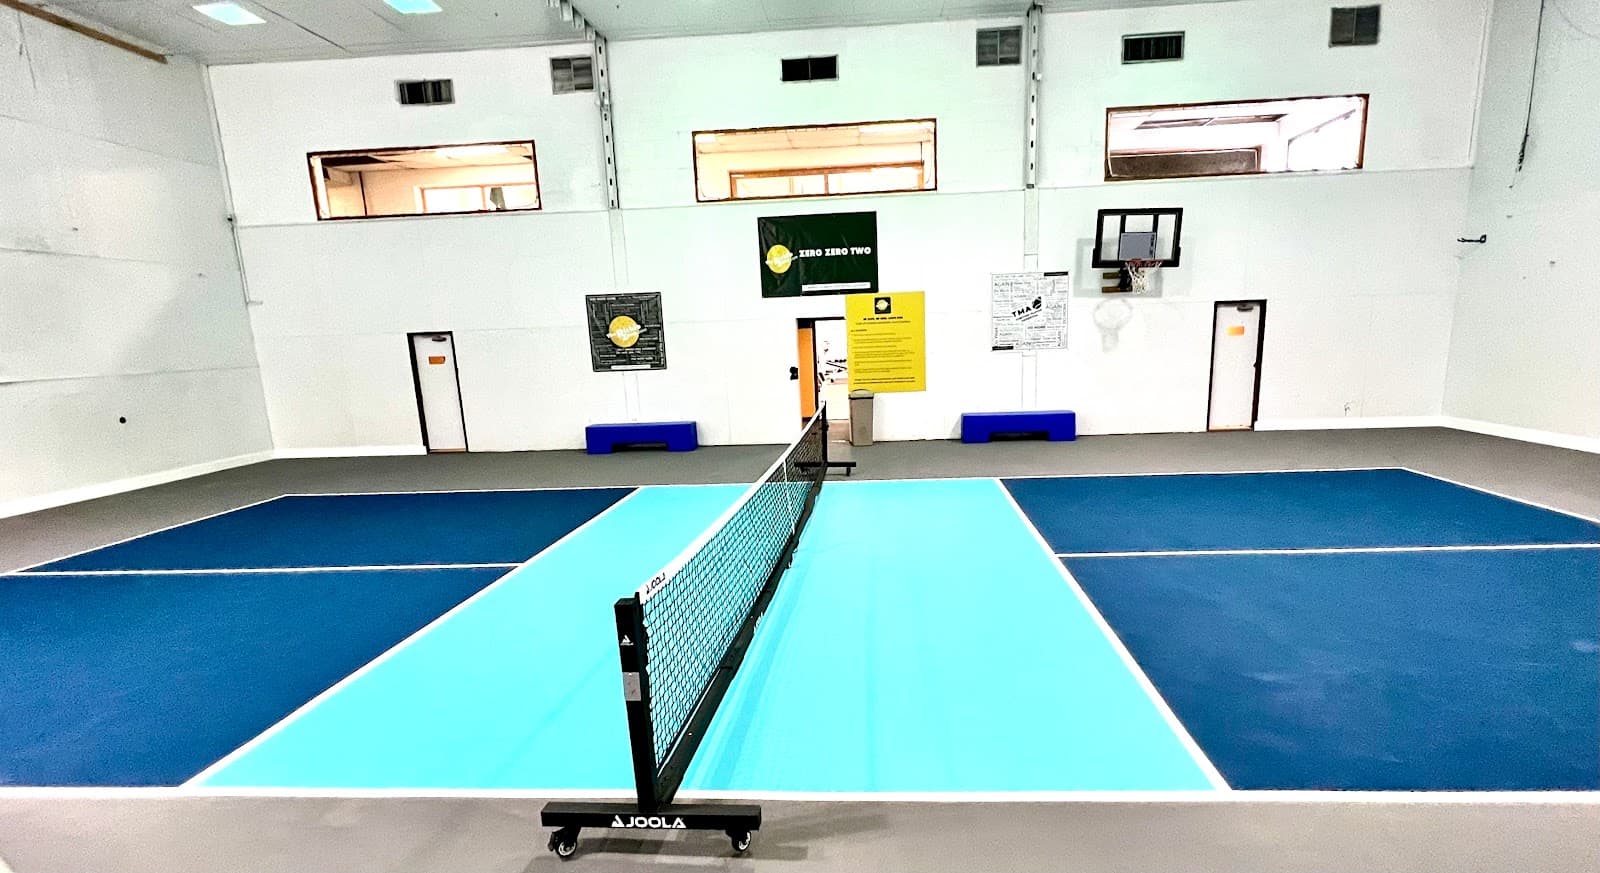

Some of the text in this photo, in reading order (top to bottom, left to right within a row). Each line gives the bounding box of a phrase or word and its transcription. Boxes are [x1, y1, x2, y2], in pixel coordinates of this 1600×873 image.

[799, 247, 871, 257] ZERO ZERO TWO
[1011, 306, 1032, 317] TMA
[626, 816, 687, 829] JOOLA
